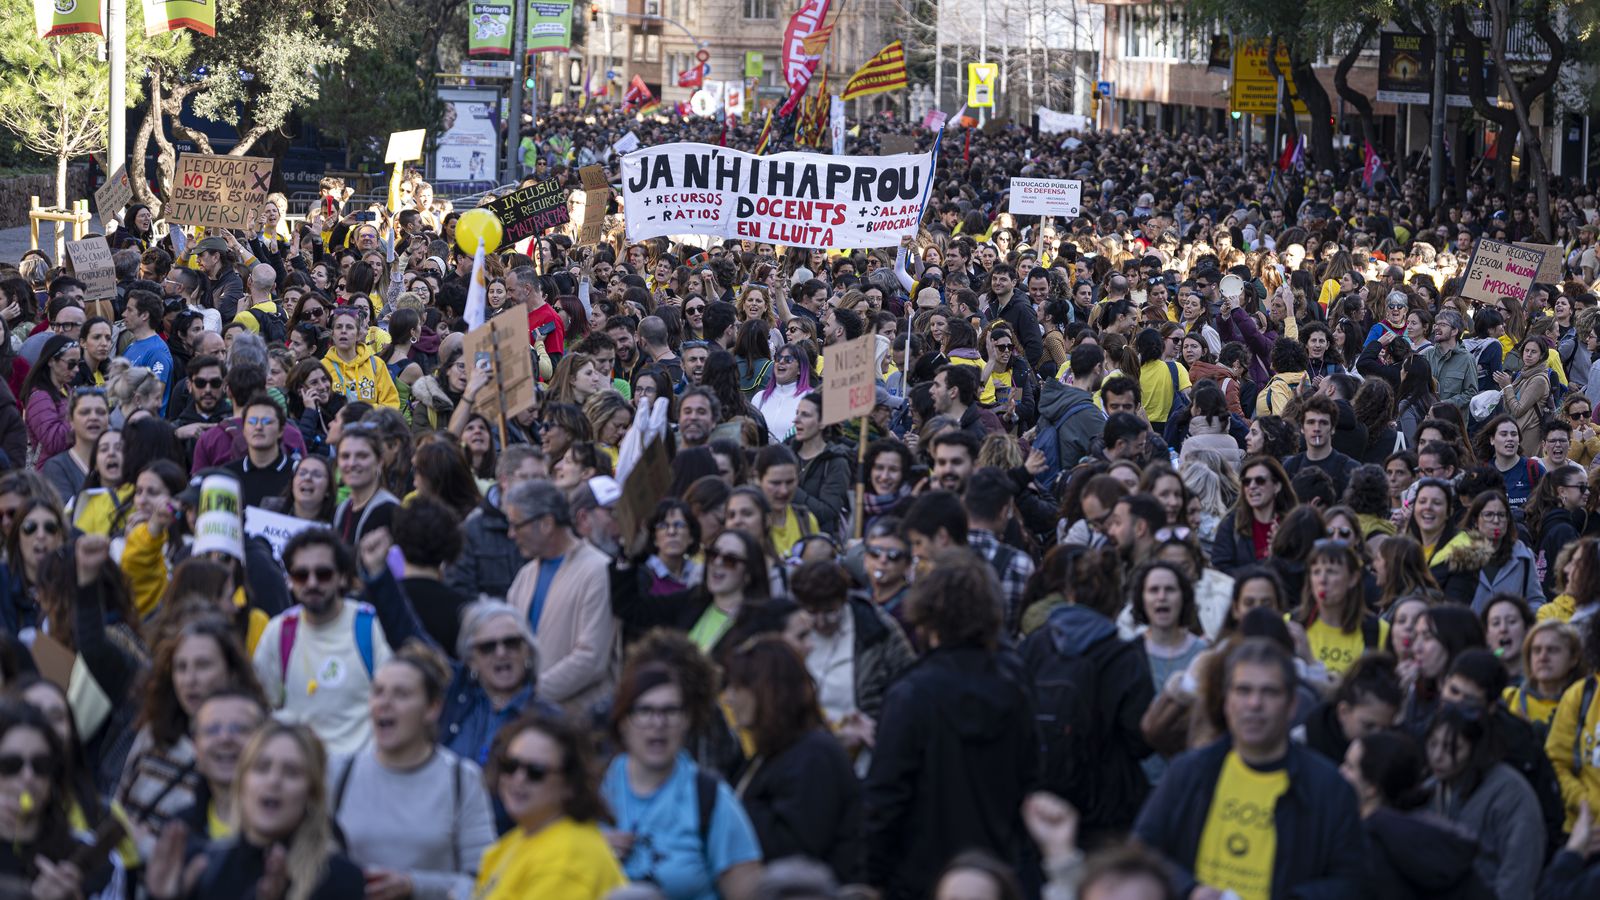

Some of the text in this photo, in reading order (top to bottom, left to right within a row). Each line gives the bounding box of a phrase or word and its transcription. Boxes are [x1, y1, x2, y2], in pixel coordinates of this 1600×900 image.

[184, 173, 203, 189] NO
[226, 177, 246, 190] UNA
[1051, 182, 1079, 190] PÚBLICA
[175, 188, 222, 204] DESPESA
[244, 193, 265, 205] UNA
[502, 178, 560, 211] INCLUSIÓ
[656, 193, 723, 206] RECURSOS
[520, 192, 567, 217] RECURSOS
[736, 196, 847, 226] DOCENTS
[172, 203, 261, 226] INVERSIÓ
[506, 205, 570, 241] MALTRACTAR
[737, 221, 761, 238] EN
[866, 215, 918, 233] BUROCRÀCI
[69, 241, 103, 253] NO VULL
[1480, 240, 1503, 254] SENSE
[1505, 246, 1541, 264] RECURSOS
[1474, 255, 1503, 271] L'ESCOLA
[1319, 646, 1352, 664] SOS
[1221, 798, 1275, 831] SOS
